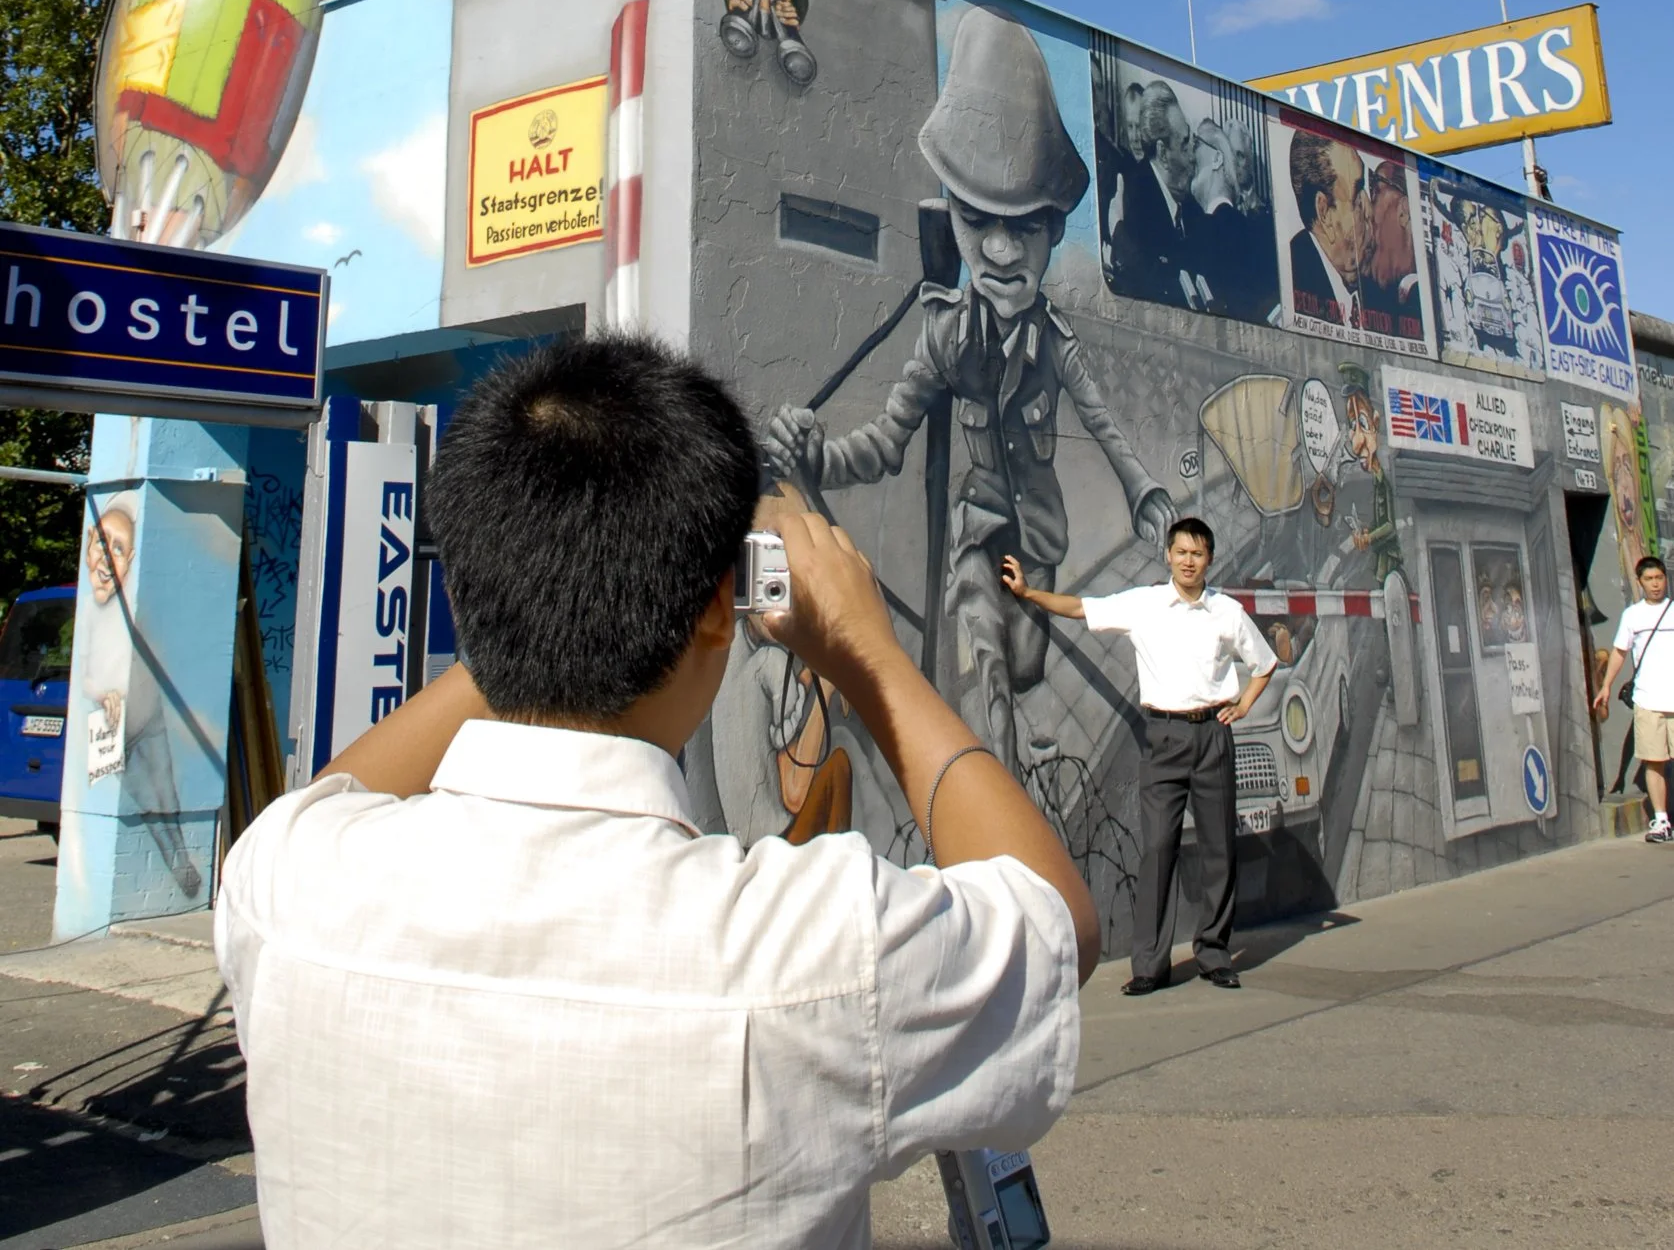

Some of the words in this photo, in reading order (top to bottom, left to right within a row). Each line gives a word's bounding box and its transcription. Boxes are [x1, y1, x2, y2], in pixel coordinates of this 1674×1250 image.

[1281, 25, 1584, 143] VENIRS
[508, 147, 574, 184] HALT
[485, 221, 544, 245] Passieren
[544, 204, 601, 234] verboten!
[1534, 205, 1577, 240] STORE
[1580, 222, 1591, 245] AT
[1594, 229, 1617, 257] THE
[4, 264, 299, 357] hostel
[1551, 349, 1598, 380] EAST-SIDE
[1599, 362, 1634, 395] GALLERY
[1476, 391, 1506, 415] ALLIED
[1469, 417, 1517, 441] CHECKPOINT
[1564, 409, 1595, 435] Eingang
[1477, 439, 1517, 462] CHARLIE
[1568, 439, 1600, 460] Entrance
[370, 481, 414, 726] EASTE
